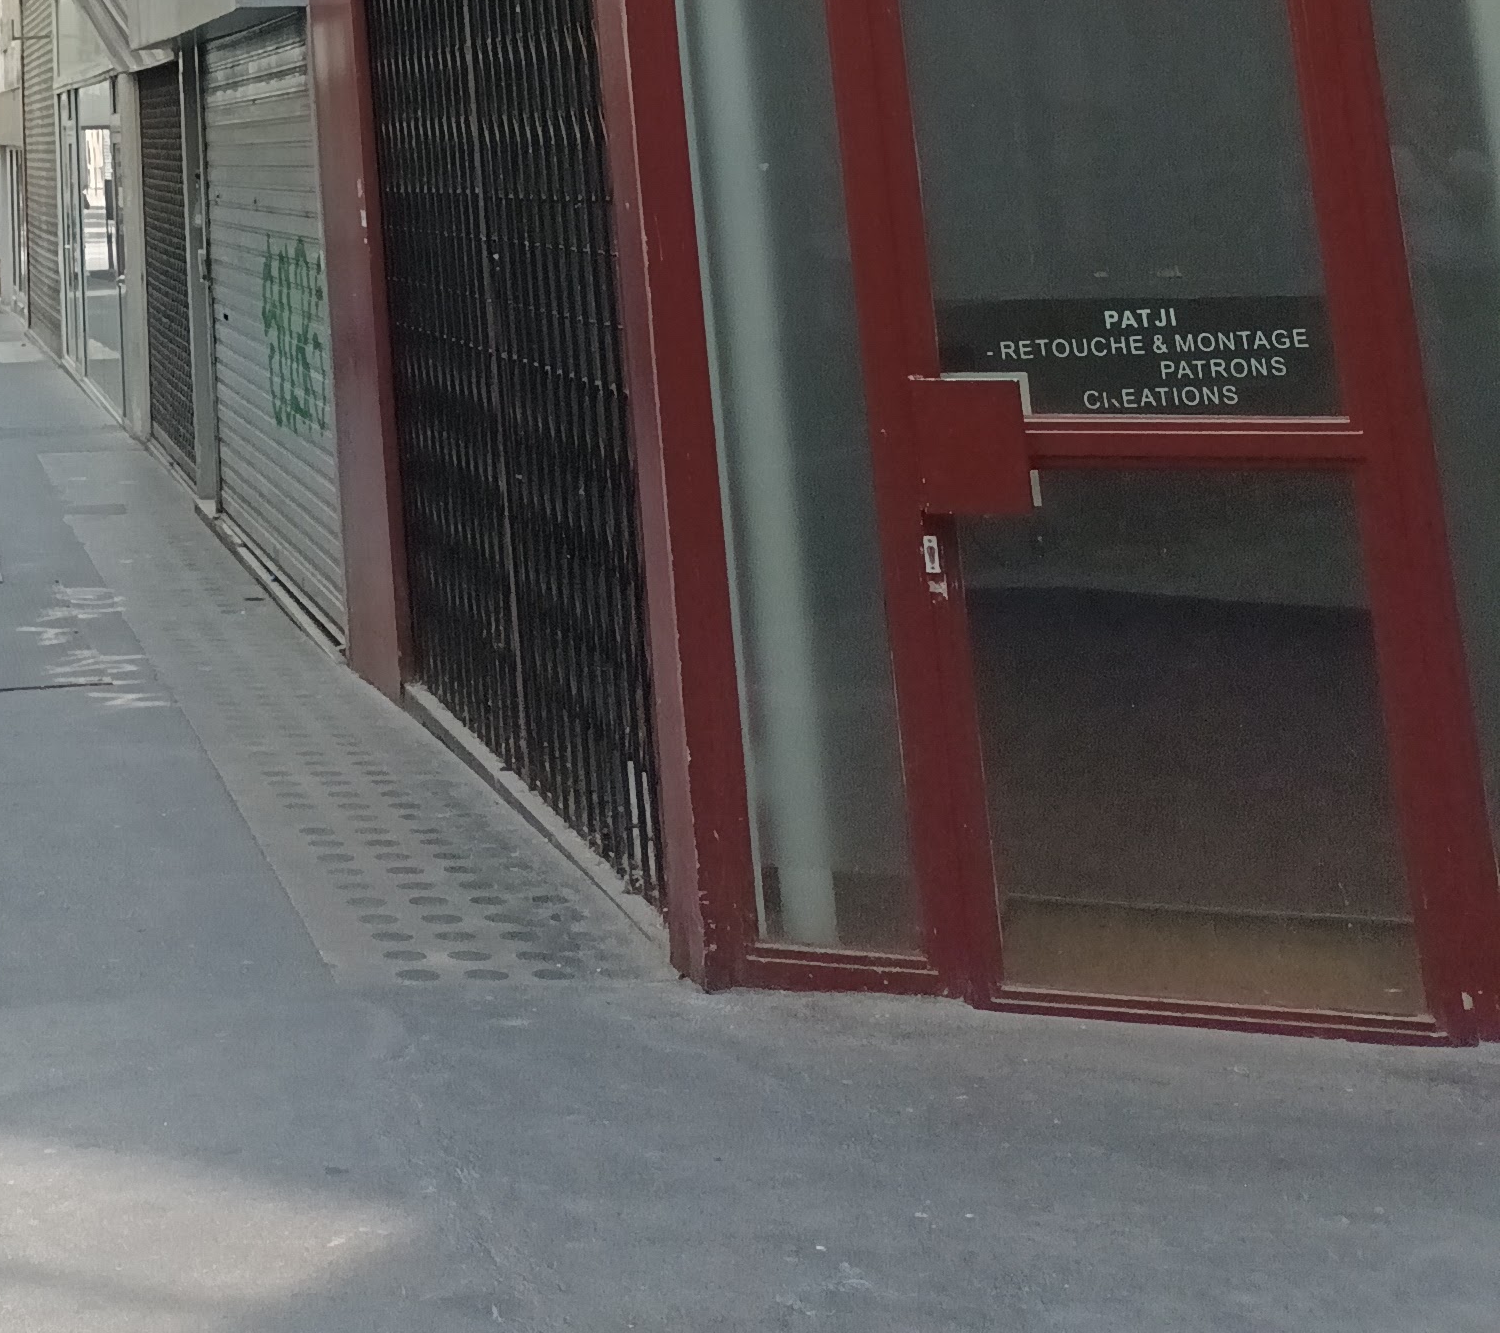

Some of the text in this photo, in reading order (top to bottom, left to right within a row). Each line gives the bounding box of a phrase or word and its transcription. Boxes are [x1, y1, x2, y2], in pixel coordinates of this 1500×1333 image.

[1104, 308, 1177, 329] PATJI
[1000, 335, 1146, 360] RETOUCHE
[1152, 335, 1168, 354] &
[1175, 328, 1310, 353] MONTAGE
[1160, 356, 1288, 380] PATRONS
